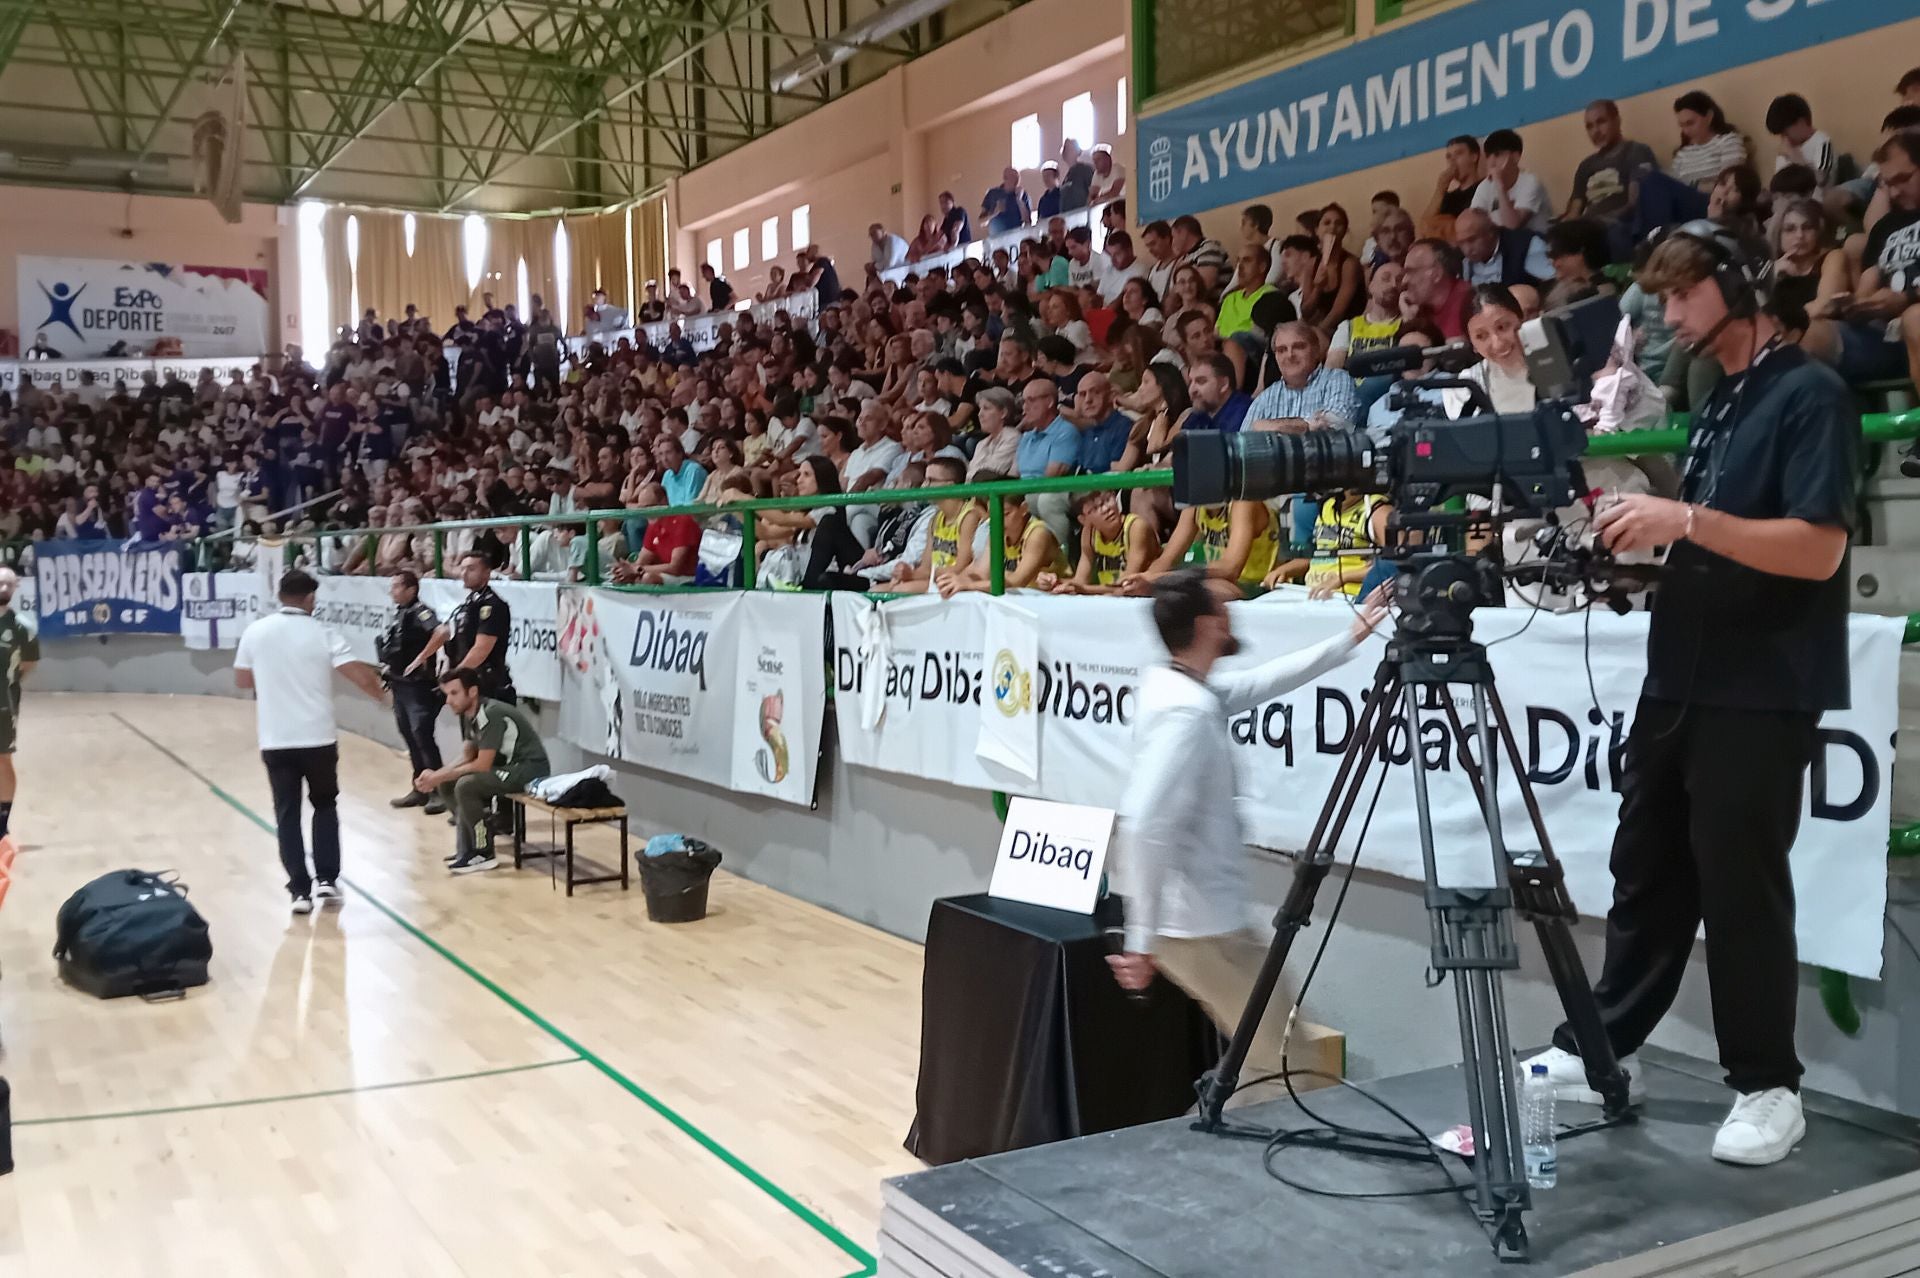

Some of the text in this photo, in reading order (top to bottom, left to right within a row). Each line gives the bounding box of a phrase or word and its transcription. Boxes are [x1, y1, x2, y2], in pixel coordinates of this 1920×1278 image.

[1181, 8, 1594, 189] AYUNTAMIENTO
[83, 308, 164, 332] DEPORTE
[37, 550, 180, 618] BERSERKERS
[629, 610, 709, 691] Dibaq
[838, 646, 915, 711] Diaq
[920, 651, 983, 707] Diba
[1009, 829, 1094, 880] Dibaq
